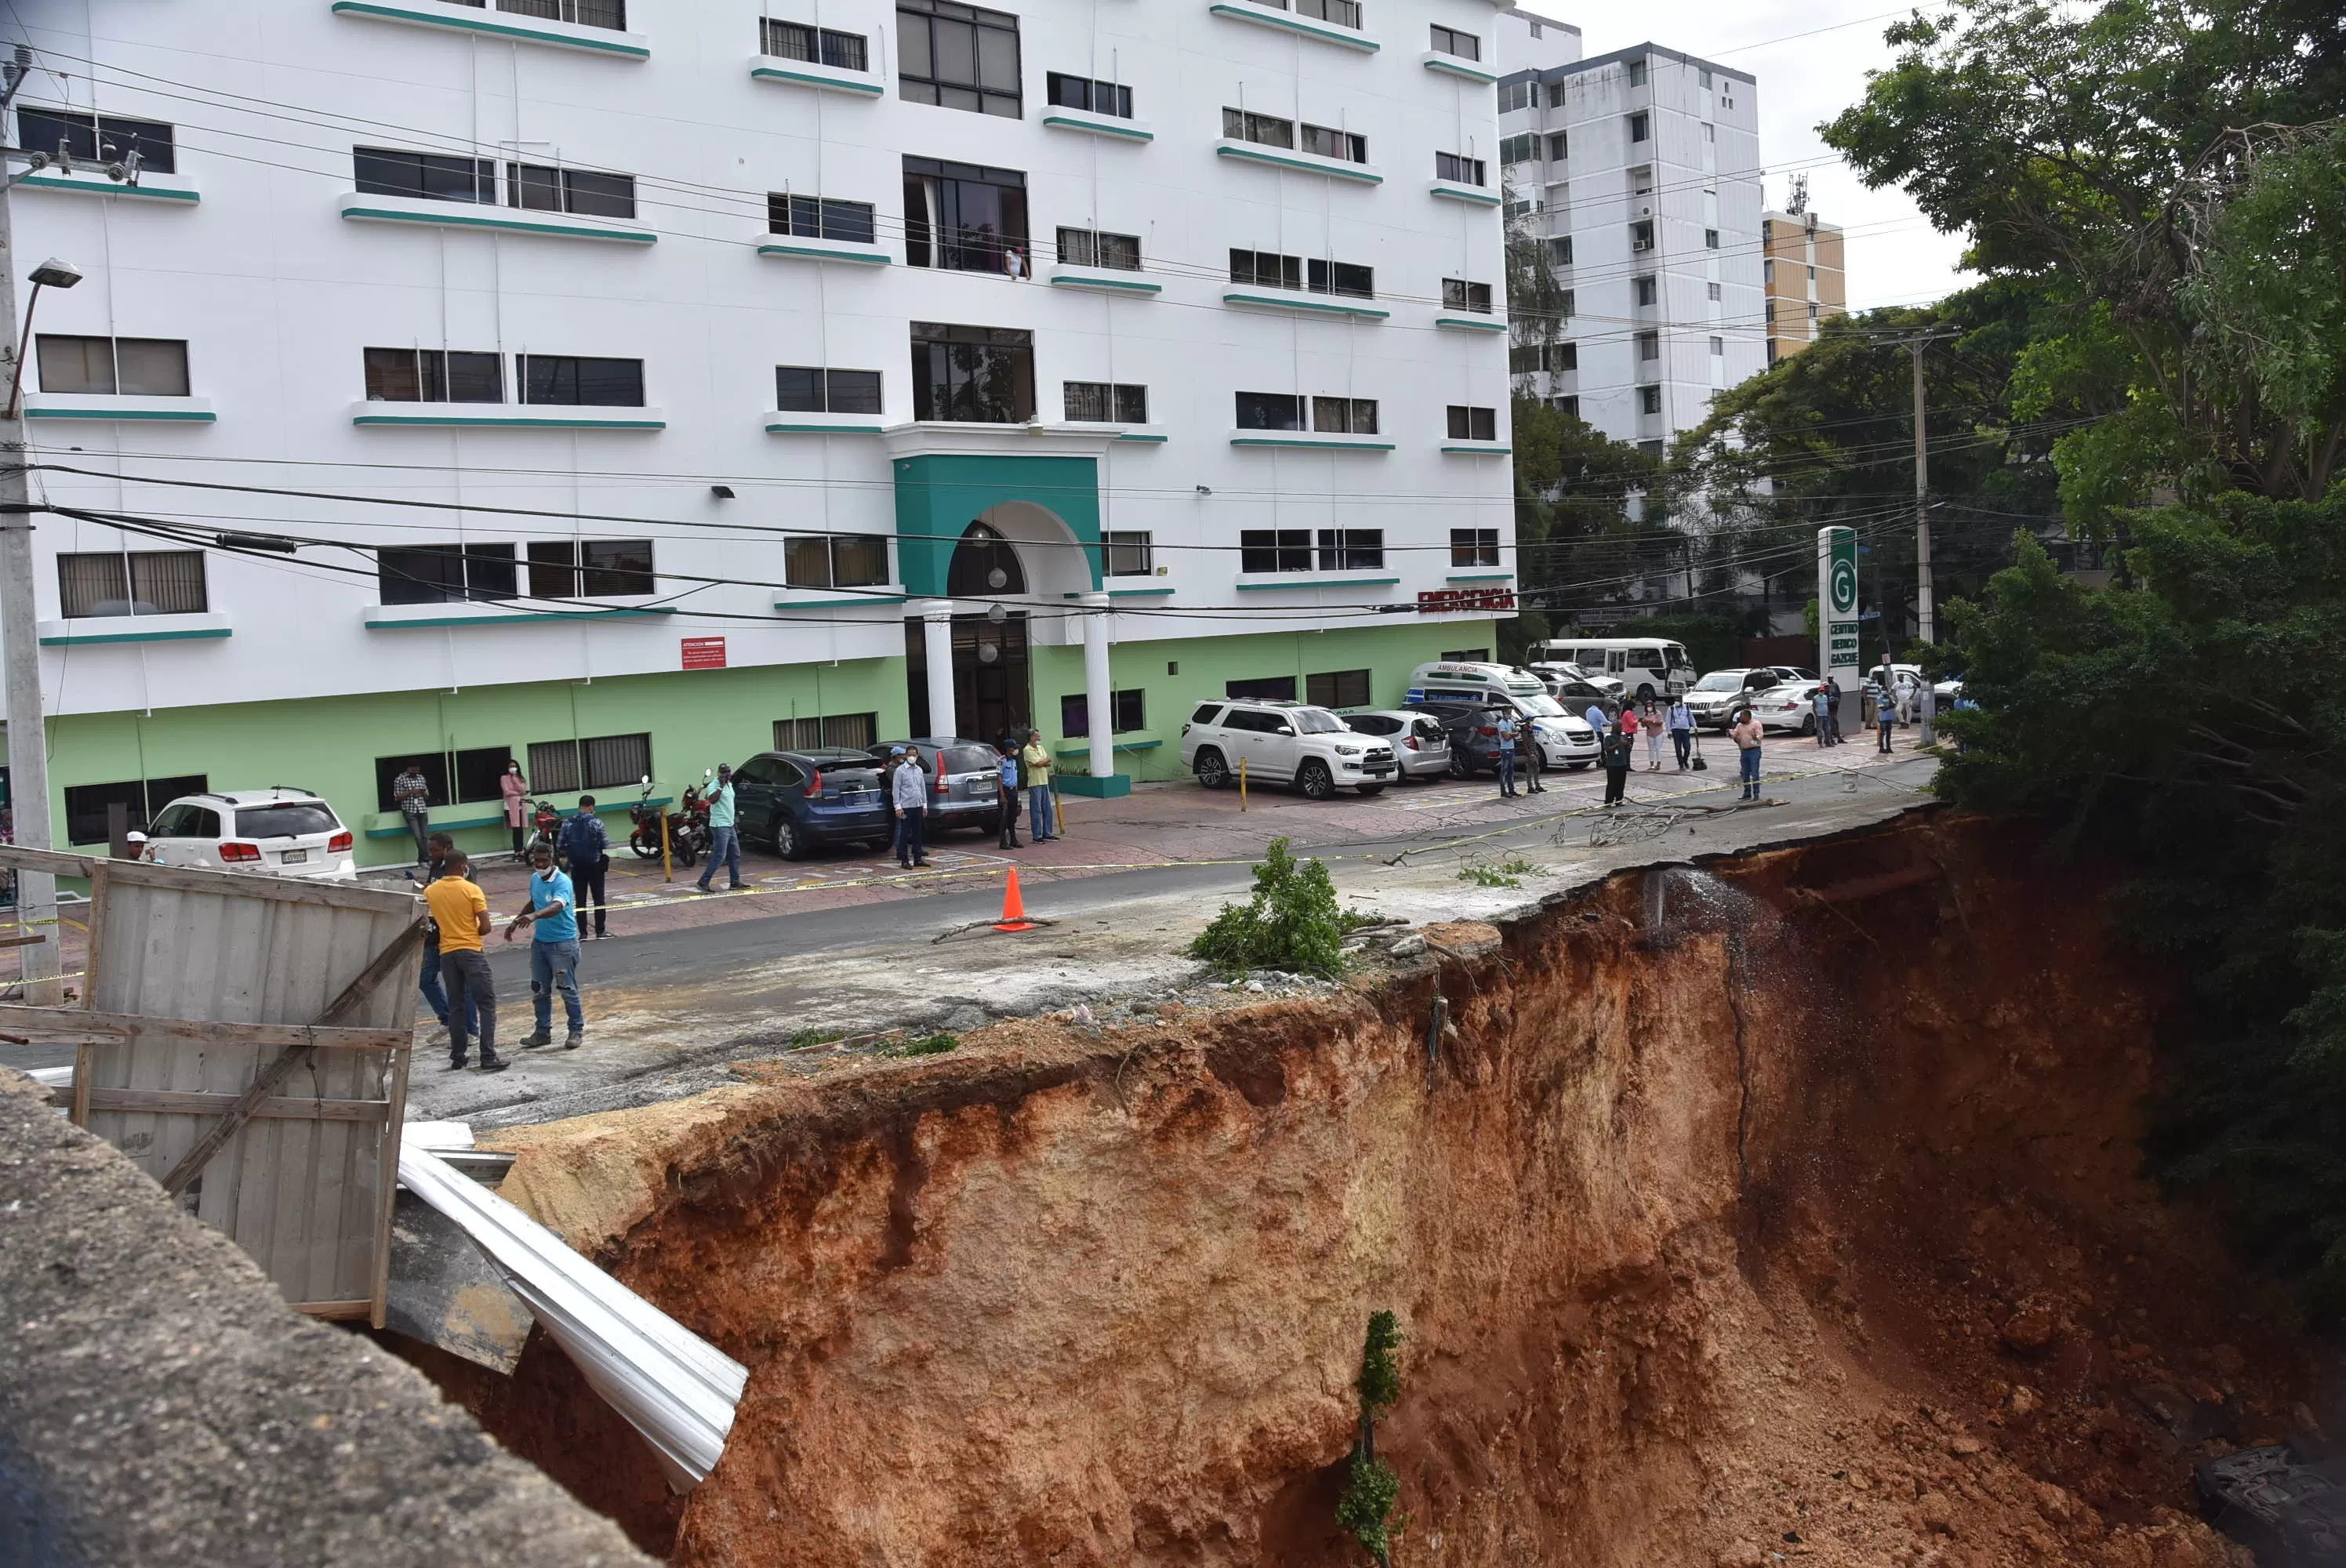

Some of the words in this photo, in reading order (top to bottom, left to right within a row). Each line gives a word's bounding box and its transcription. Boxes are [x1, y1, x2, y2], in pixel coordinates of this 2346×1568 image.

[1836, 570, 1850, 604] G
[1418, 588, 1515, 614] EMERGENCIA
[1830, 623, 1858, 635] CENTRO
[1437, 664, 1478, 673] AMBULANCIA
